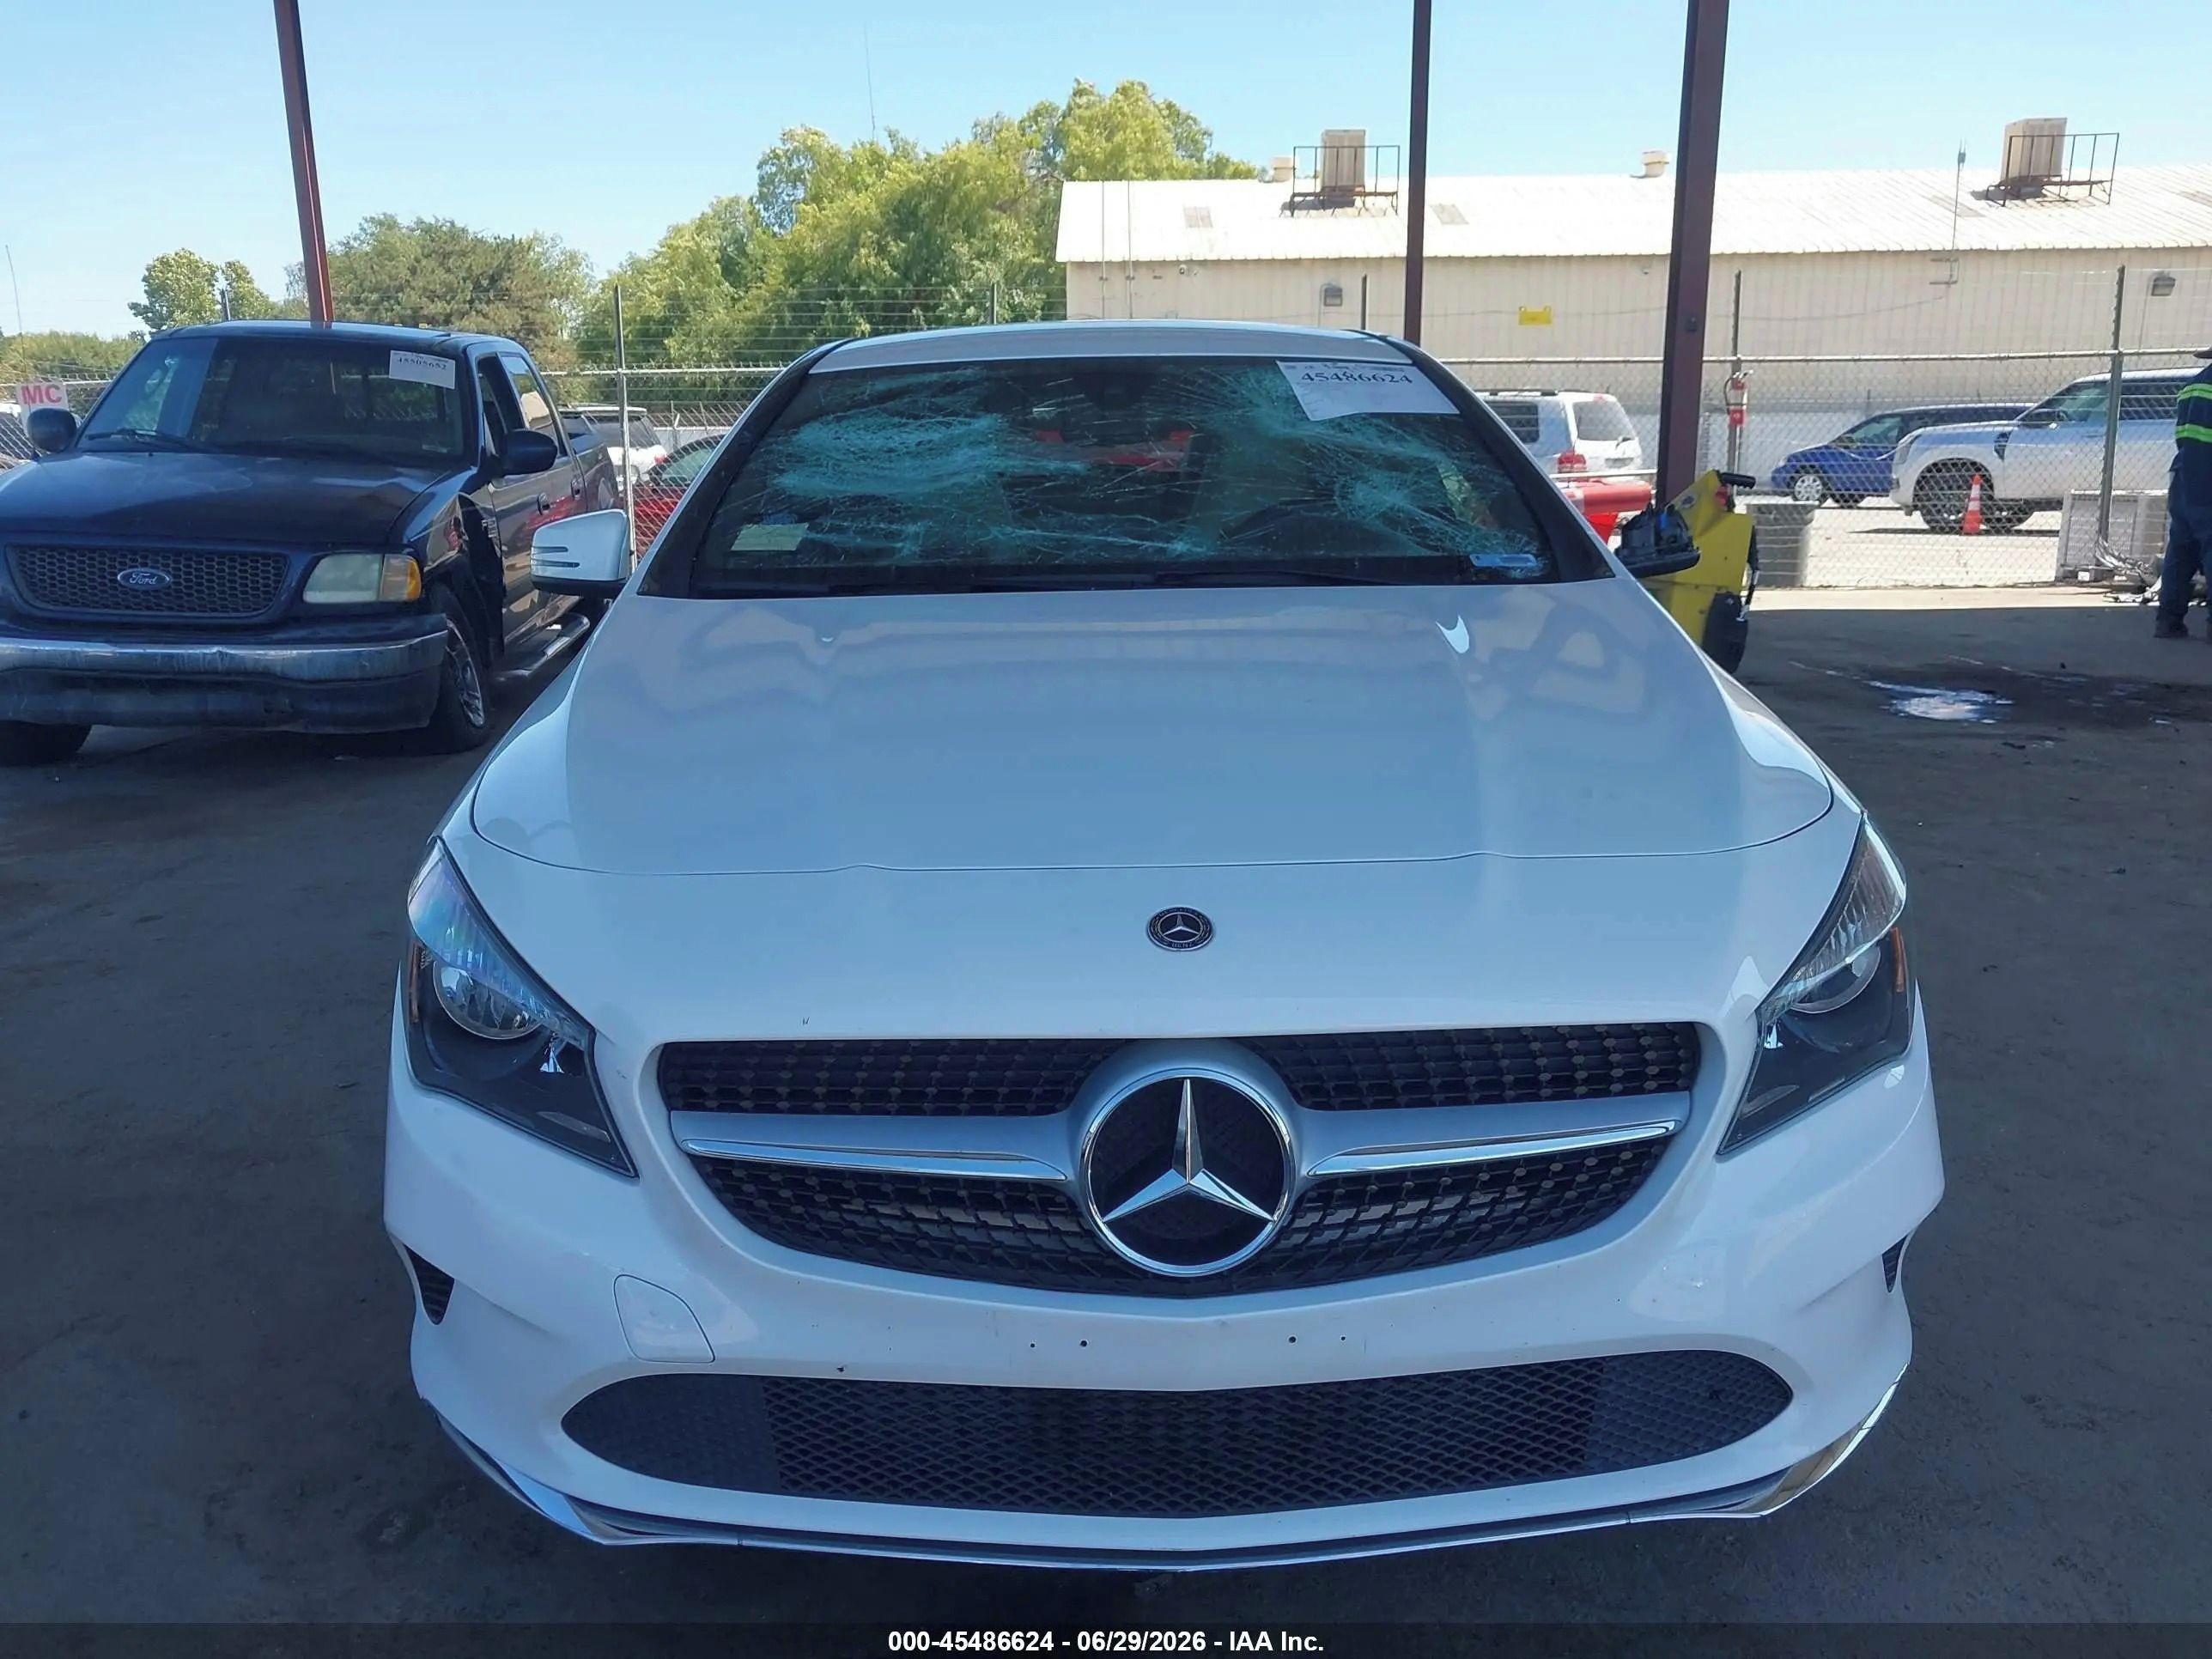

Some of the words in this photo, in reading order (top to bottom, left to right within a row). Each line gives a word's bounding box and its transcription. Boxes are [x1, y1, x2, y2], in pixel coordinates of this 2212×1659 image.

[1301, 370, 1413, 385] 45486624
[21, 384, 63, 404] MC
[129, 572, 158, 585] Ford
